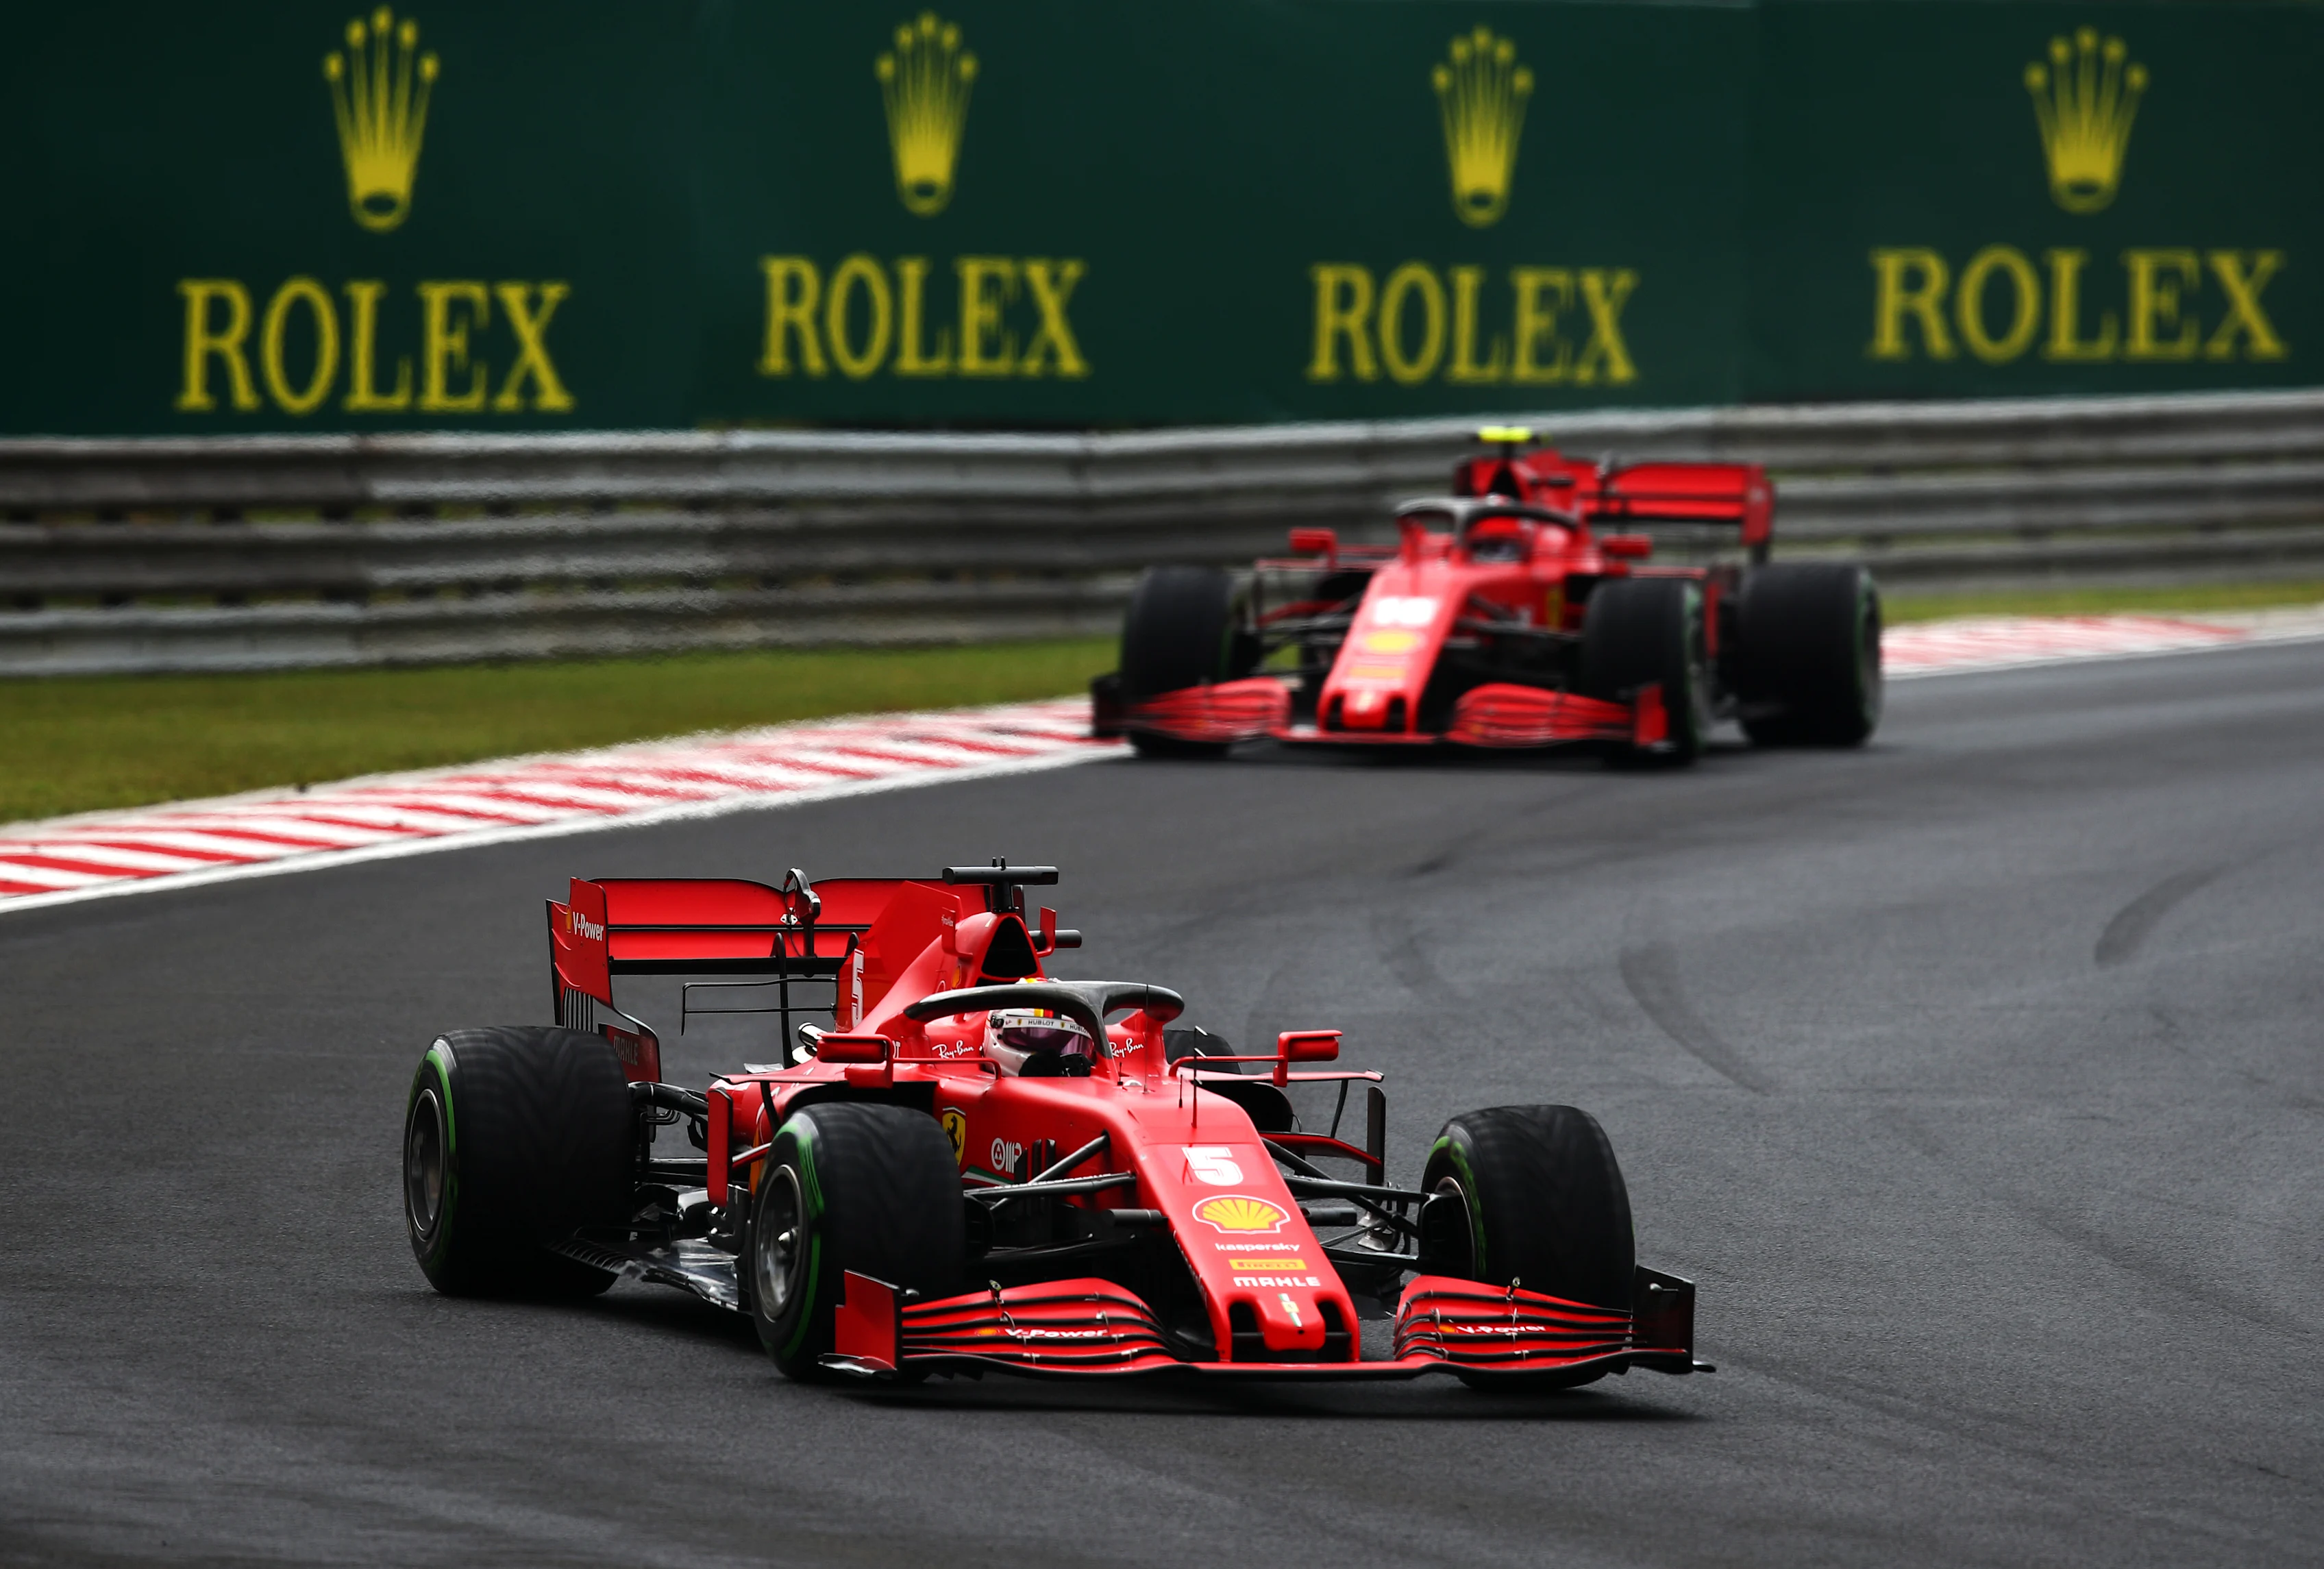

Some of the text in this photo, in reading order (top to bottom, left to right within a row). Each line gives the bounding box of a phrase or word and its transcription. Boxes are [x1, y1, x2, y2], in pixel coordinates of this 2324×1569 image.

[762, 255, 1087, 377] ROLEX
[1310, 263, 1635, 384] ROLEX
[1872, 247, 2284, 360] ROLEX
[178, 277, 572, 413] ROLEX
[573, 911, 604, 941] V-Power
[852, 948, 864, 1029] 5
[1070, 1024, 1089, 1035] HUBLO
[1181, 1146, 1244, 1187] 5
[1215, 1243, 1300, 1252] kaspersky
[1233, 1276, 1320, 1287] MAHLE
[1005, 1328, 1108, 1337] V-Power
